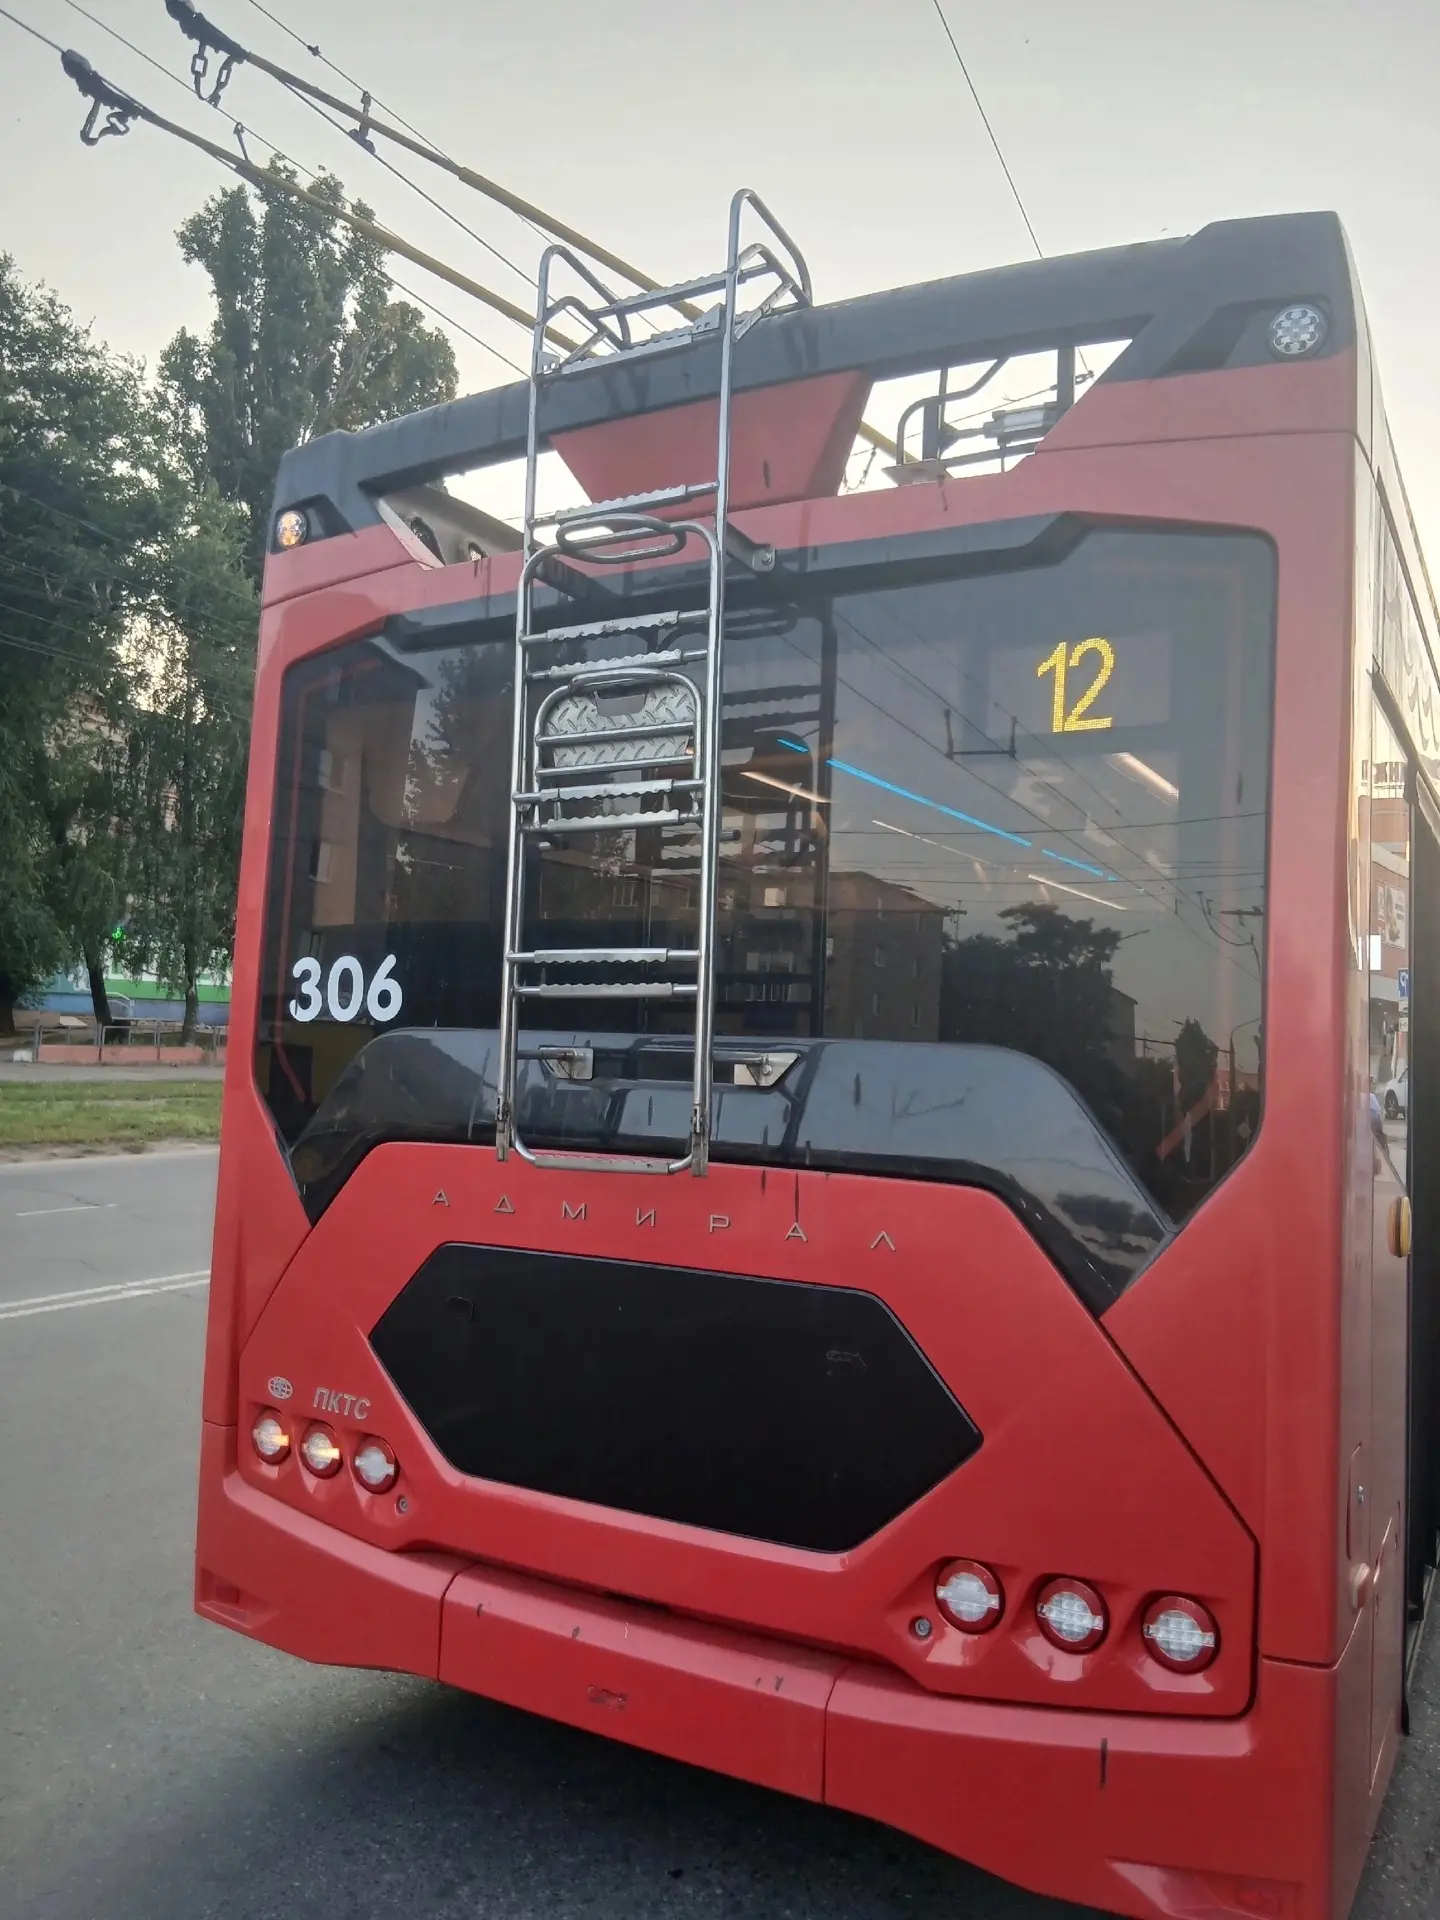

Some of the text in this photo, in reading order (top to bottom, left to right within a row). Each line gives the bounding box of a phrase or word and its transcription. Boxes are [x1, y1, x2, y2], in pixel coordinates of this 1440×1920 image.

[1037, 637, 1114, 733] 12
[289, 953, 403, 1022] 306
[432, 1188, 896, 1252] АДМИРАЛ
[312, 1386, 371, 1420] ПКТС
